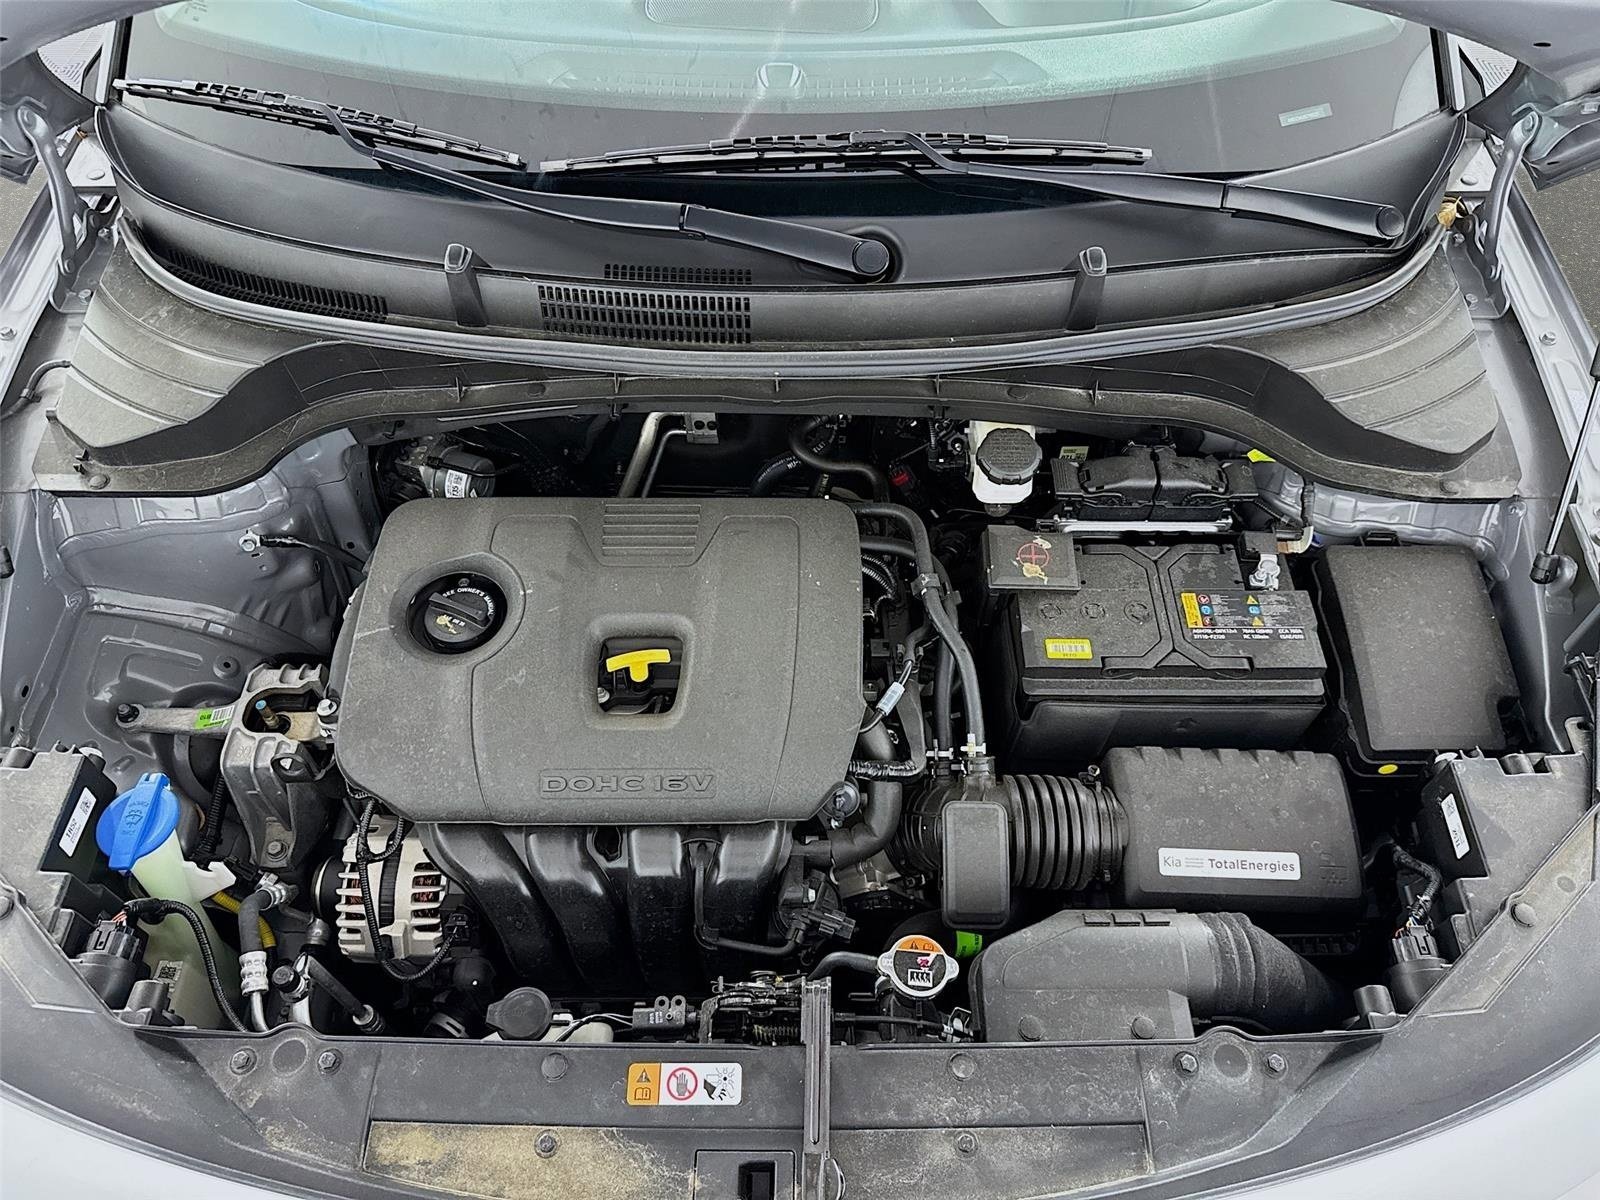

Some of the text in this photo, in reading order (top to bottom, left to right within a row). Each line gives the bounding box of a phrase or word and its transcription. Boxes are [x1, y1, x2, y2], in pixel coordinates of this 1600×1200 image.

[442, 587, 495, 616] SEE OWNER'S MANUAL
[542, 774, 714, 793] DOHC 16V
[1163, 856, 1182, 868] Kia
[1207, 858, 1296, 873] TotalEnergies
